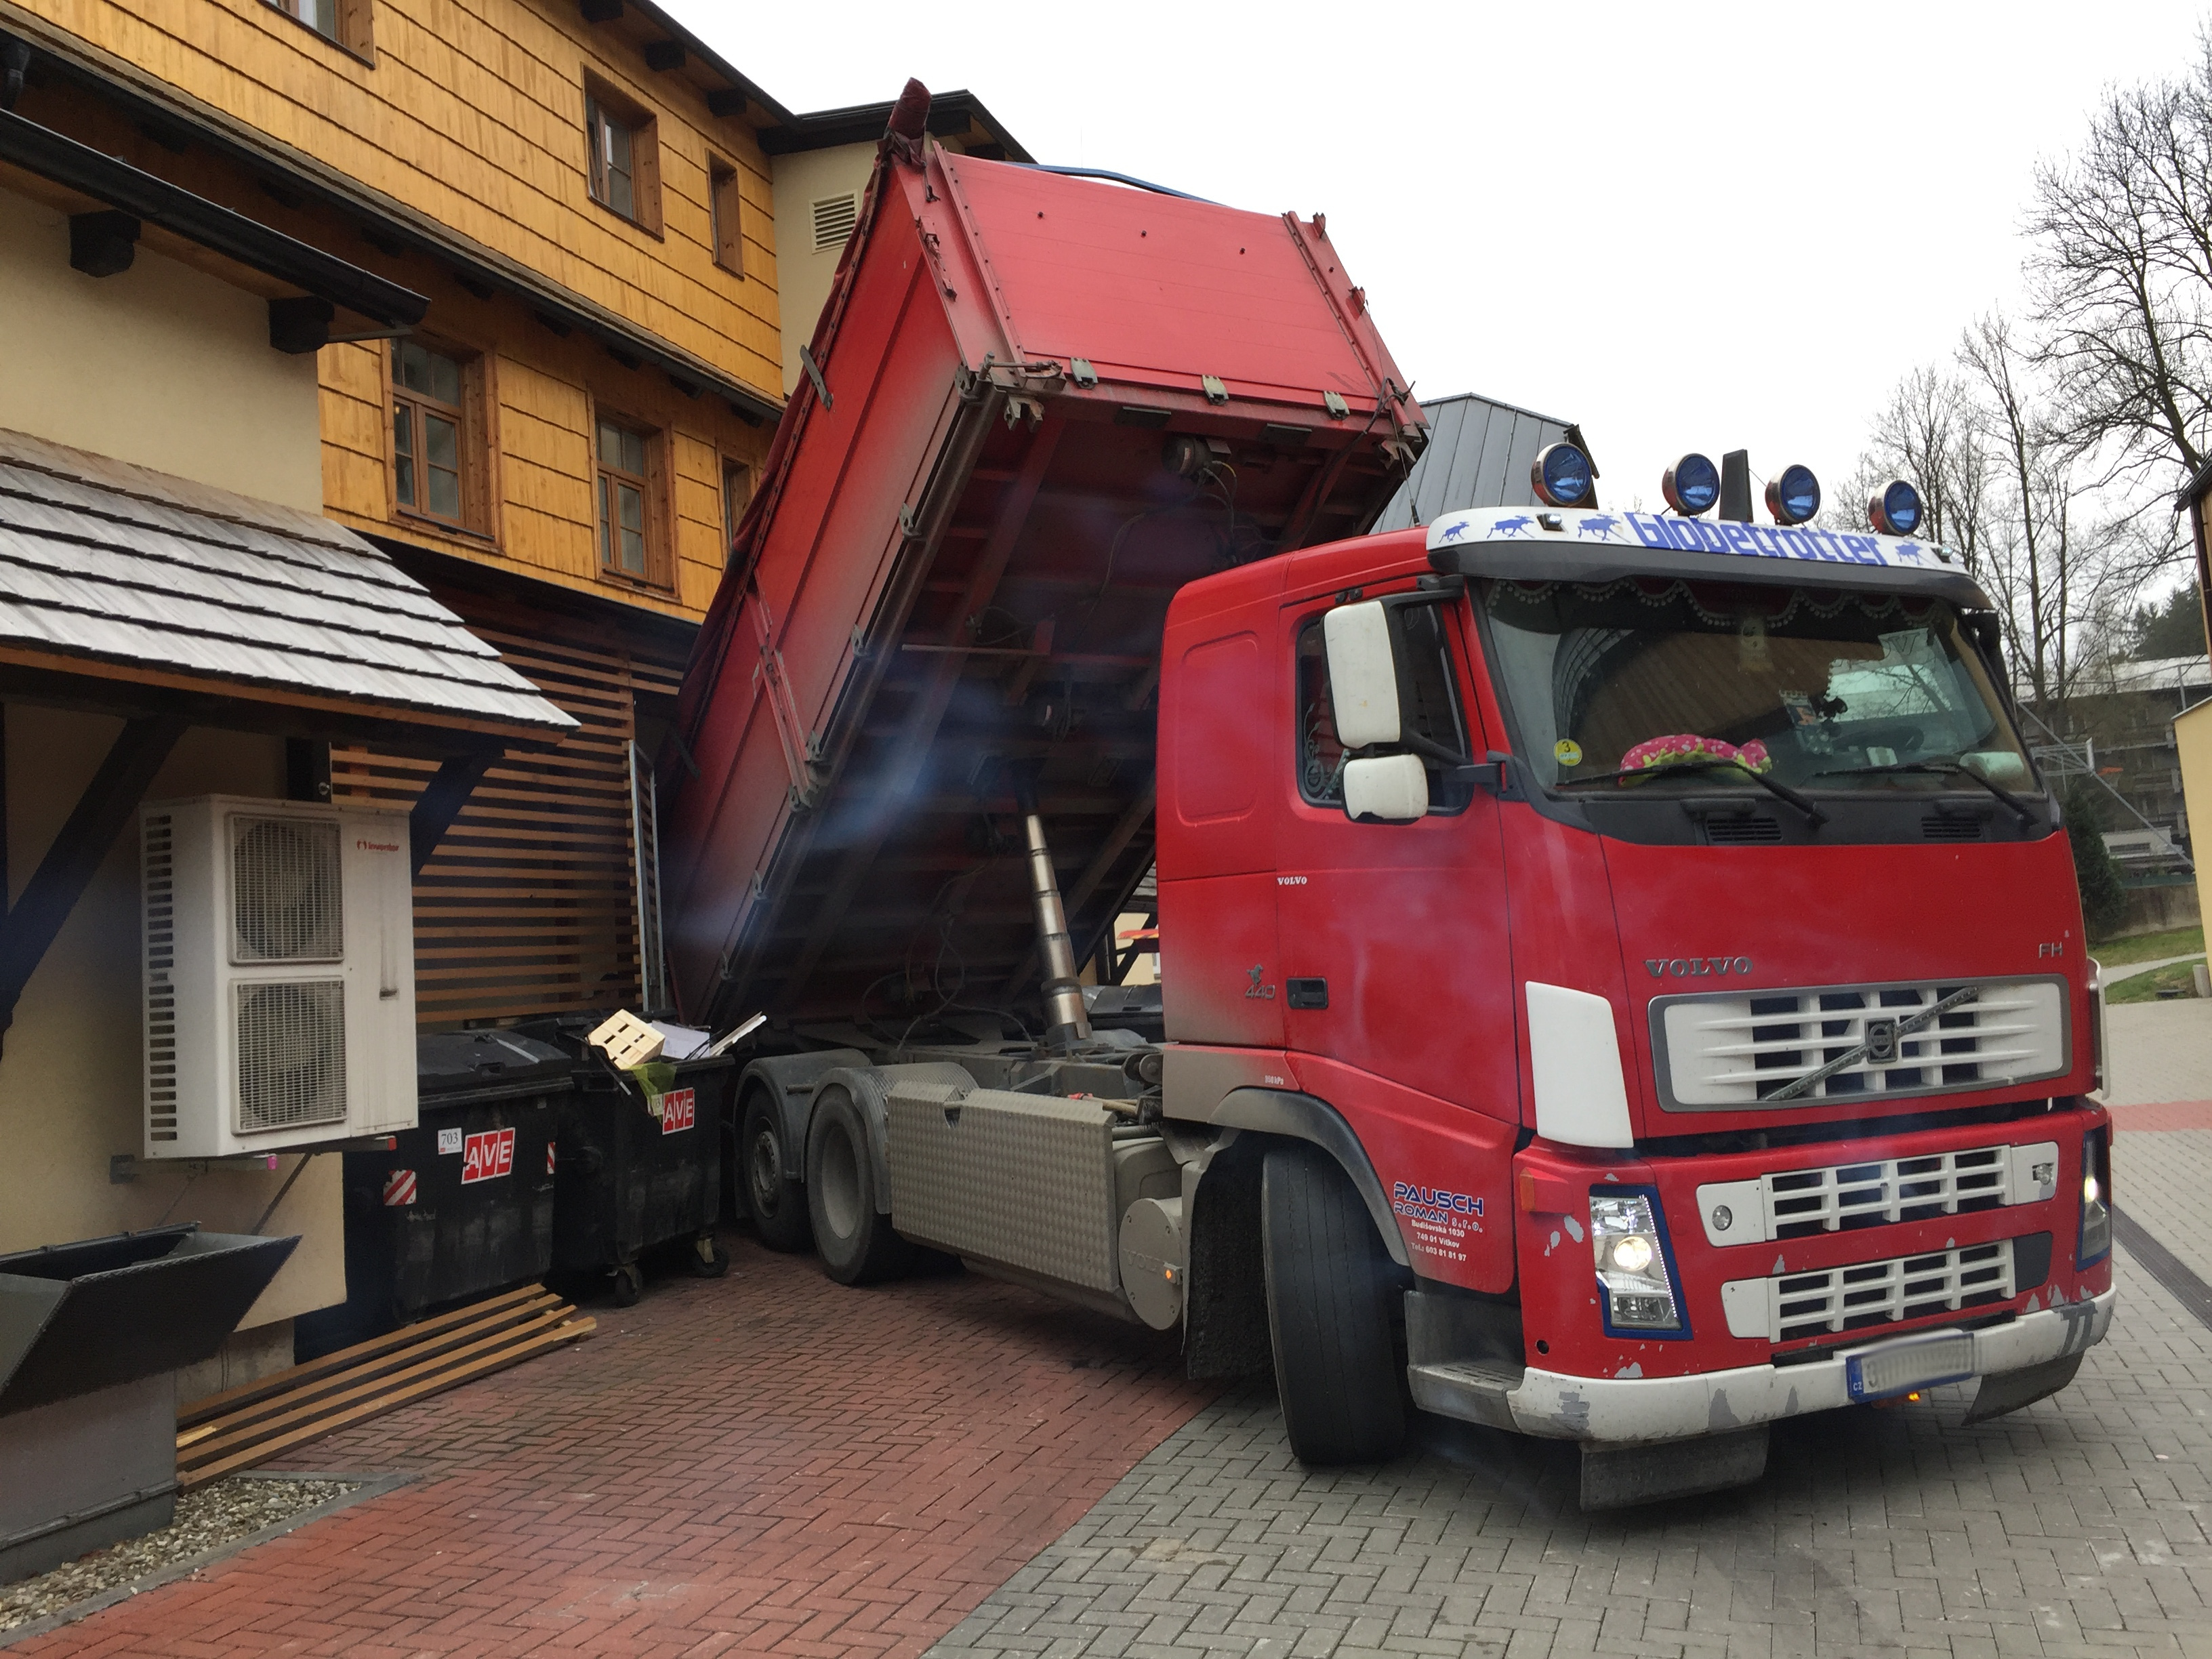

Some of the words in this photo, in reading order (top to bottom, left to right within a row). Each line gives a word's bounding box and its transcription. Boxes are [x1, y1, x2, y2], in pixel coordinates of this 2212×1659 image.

[1623, 512, 1889, 567] Globetrotter
[1277, 876, 1307, 885] VOLVO
[2039, 941, 2063, 959] FH
[1645, 956, 1753, 977] VOLVO
[664, 1098, 693, 1123] AVE
[441, 1132, 458, 1146] 703
[466, 1141, 512, 1170] AVE
[1394, 1181, 1483, 1216] PAUSCH
[1394, 1201, 1448, 1224] ROMAN
[1452, 1217, 1483, 1233] s.r.o.
[1429, 1235, 1437, 1243] 01
[1448, 1227, 1465, 1237] 1030
[1425, 1245, 1437, 1255] 603
[1438, 1248, 1446, 1257] 81
[1448, 1250, 1456, 1260] 81
[1458, 1252, 1467, 1262] 97
[1853, 1381, 1862, 1391] CZ
